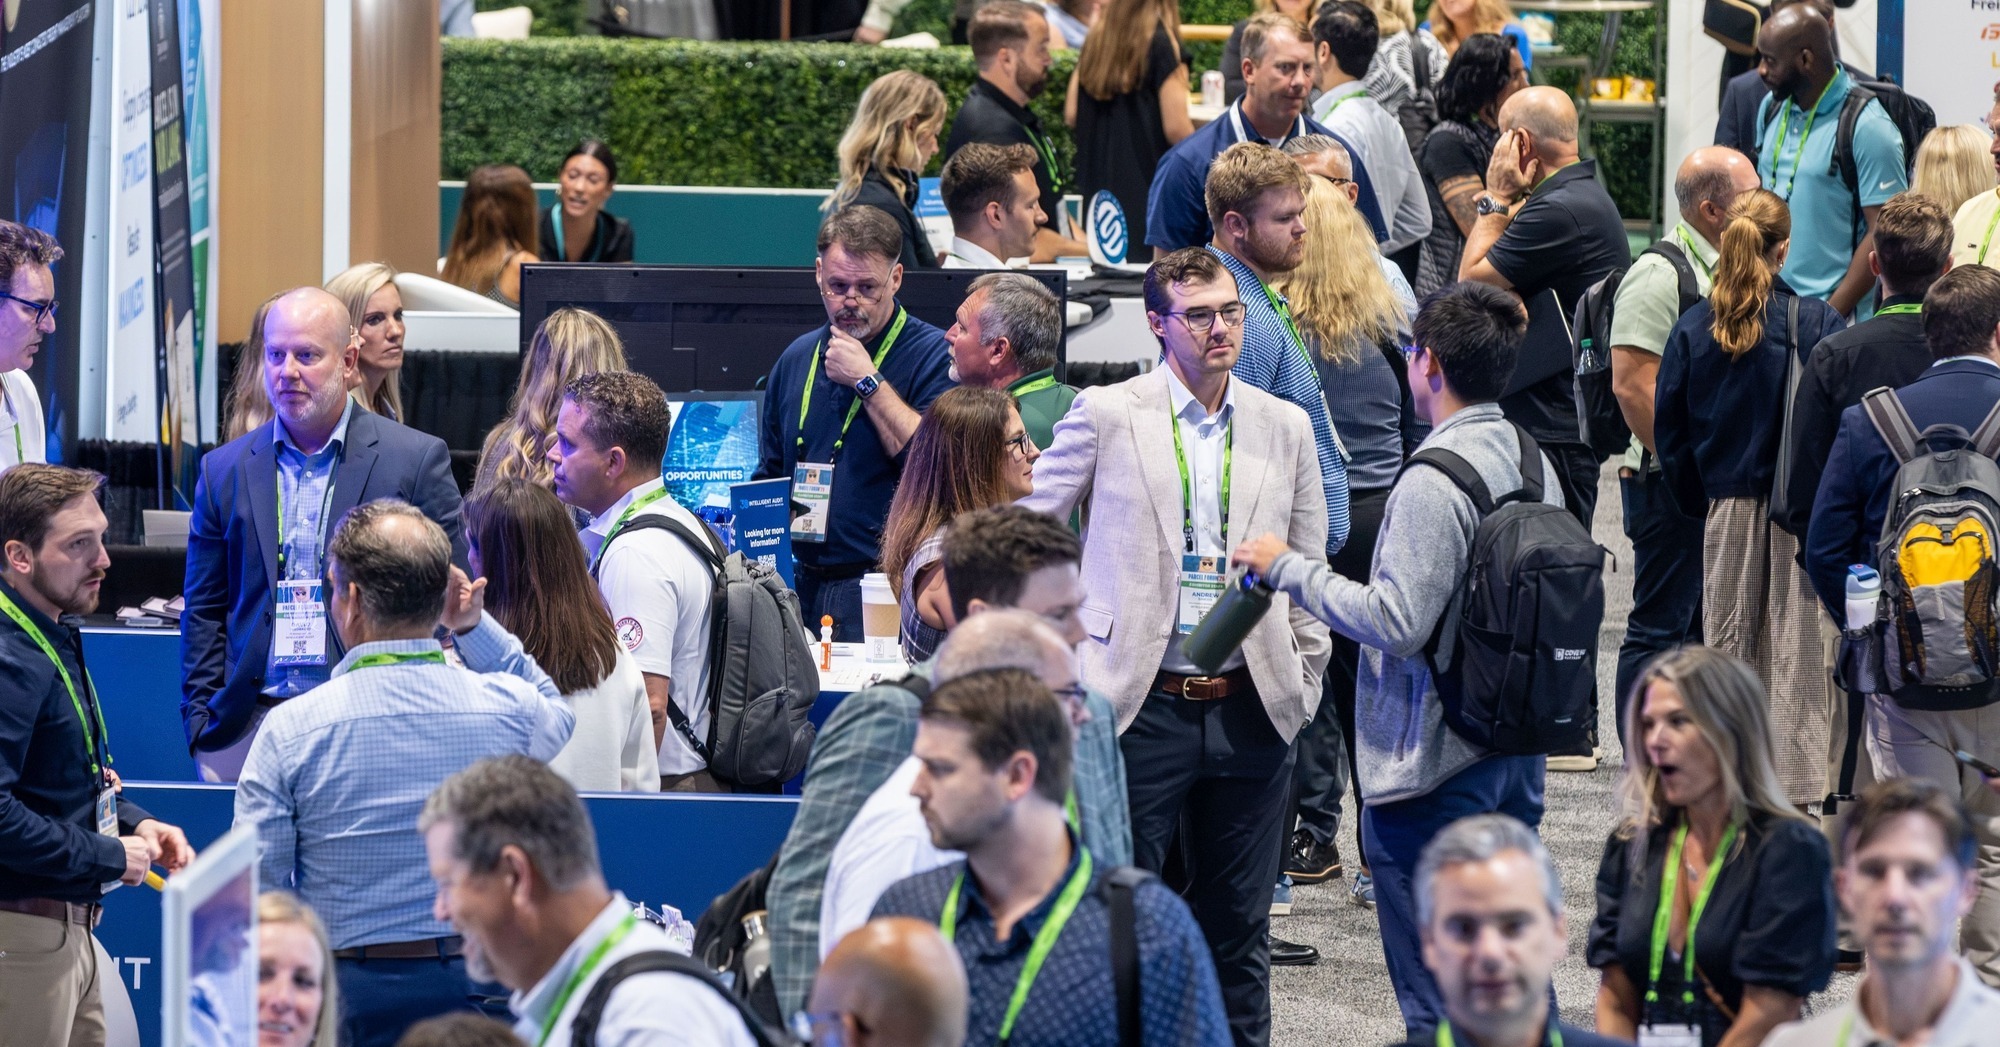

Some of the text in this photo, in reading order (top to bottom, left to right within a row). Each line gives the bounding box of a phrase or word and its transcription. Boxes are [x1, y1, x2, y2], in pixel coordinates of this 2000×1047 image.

[665, 470, 743, 481] OPPORTUNITIES
[744, 529, 764, 538] Looking
[771, 527, 785, 535] more
[750, 536, 780, 548] information?
[1188, 573, 1203, 581] PARCEL
